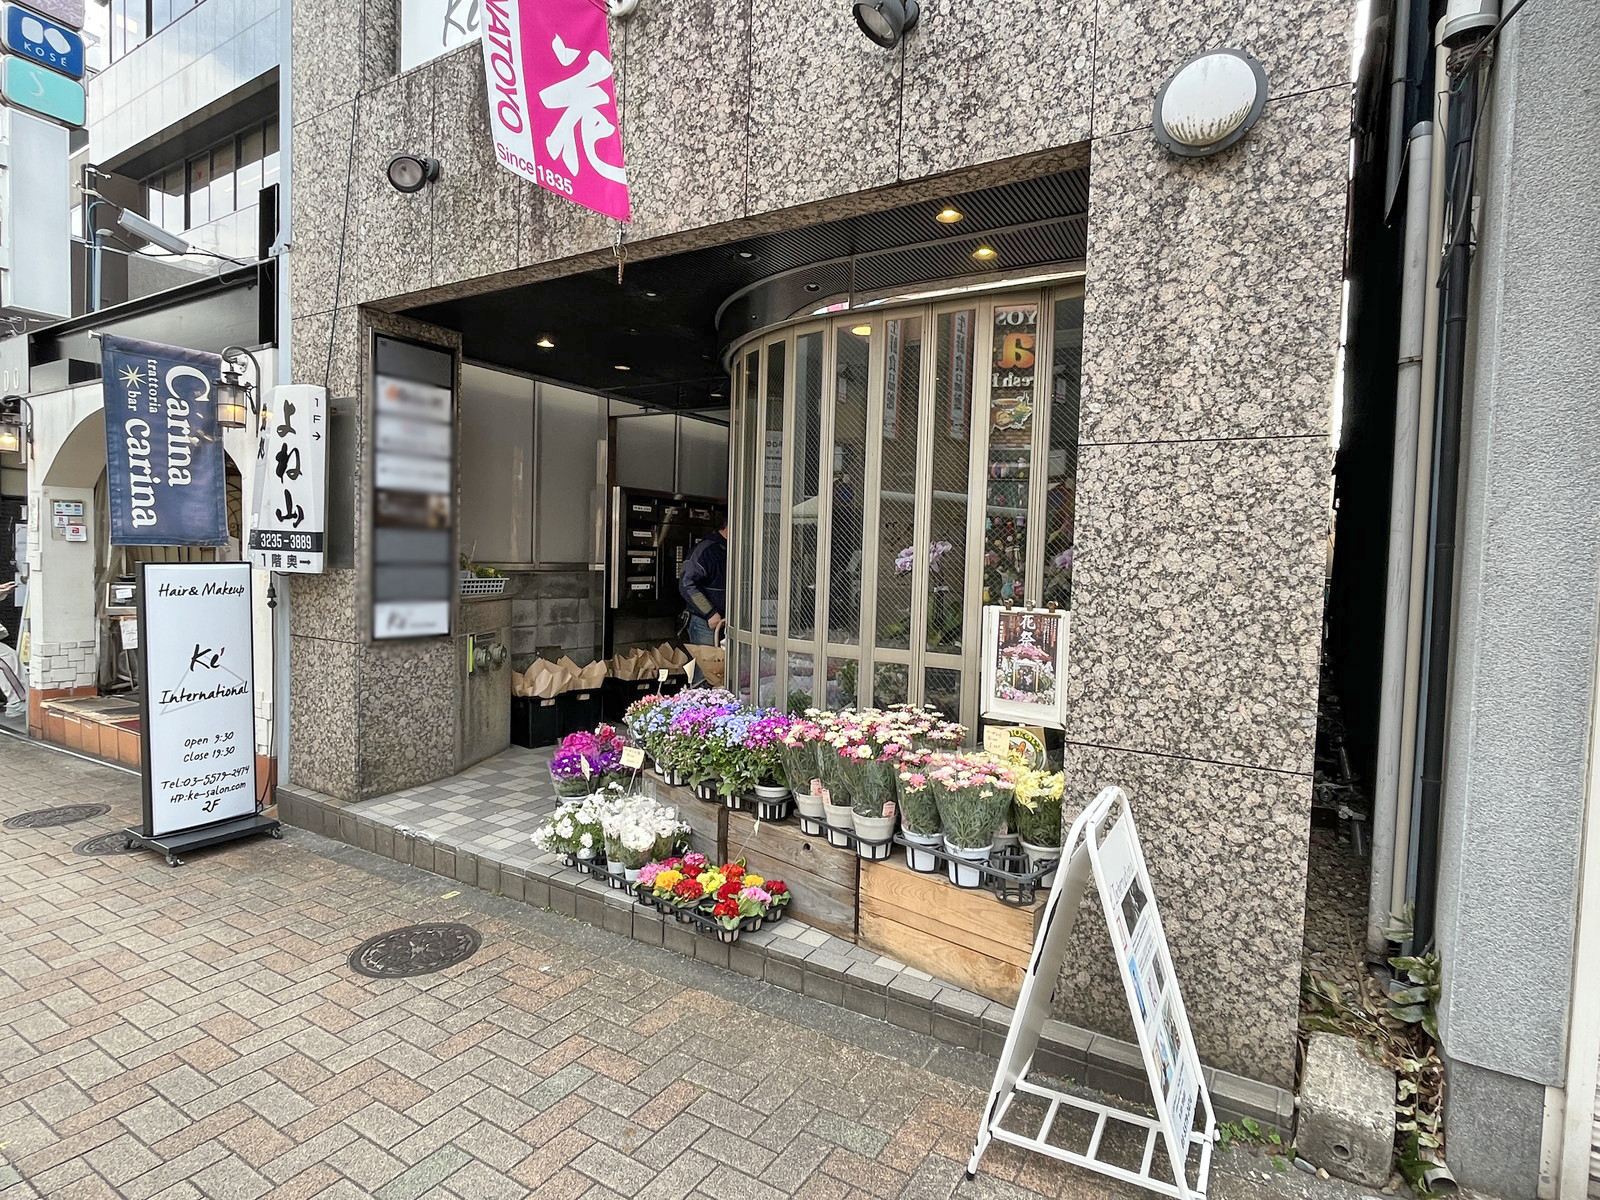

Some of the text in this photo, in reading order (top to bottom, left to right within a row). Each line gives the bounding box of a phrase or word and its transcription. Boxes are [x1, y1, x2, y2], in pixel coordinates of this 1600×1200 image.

[23, 41, 67, 67] KOSÉ
[538, 33, 628, 185] 花
[496, 141, 574, 195] Since 1835
[147, 359, 162, 414] trattoria
[127, 390, 142, 412] bar
[165, 365, 211, 487] Carina
[275, 399, 305, 529] よね山
[260, 533, 312, 550] 3235-3889
[201, 580, 245, 598] Makeup
[158, 680, 249, 705] International
[184, 731, 234, 749] Open 9:30
[183, 745, 236, 763] Close 19:30
[202, 798, 221, 813] 2F
